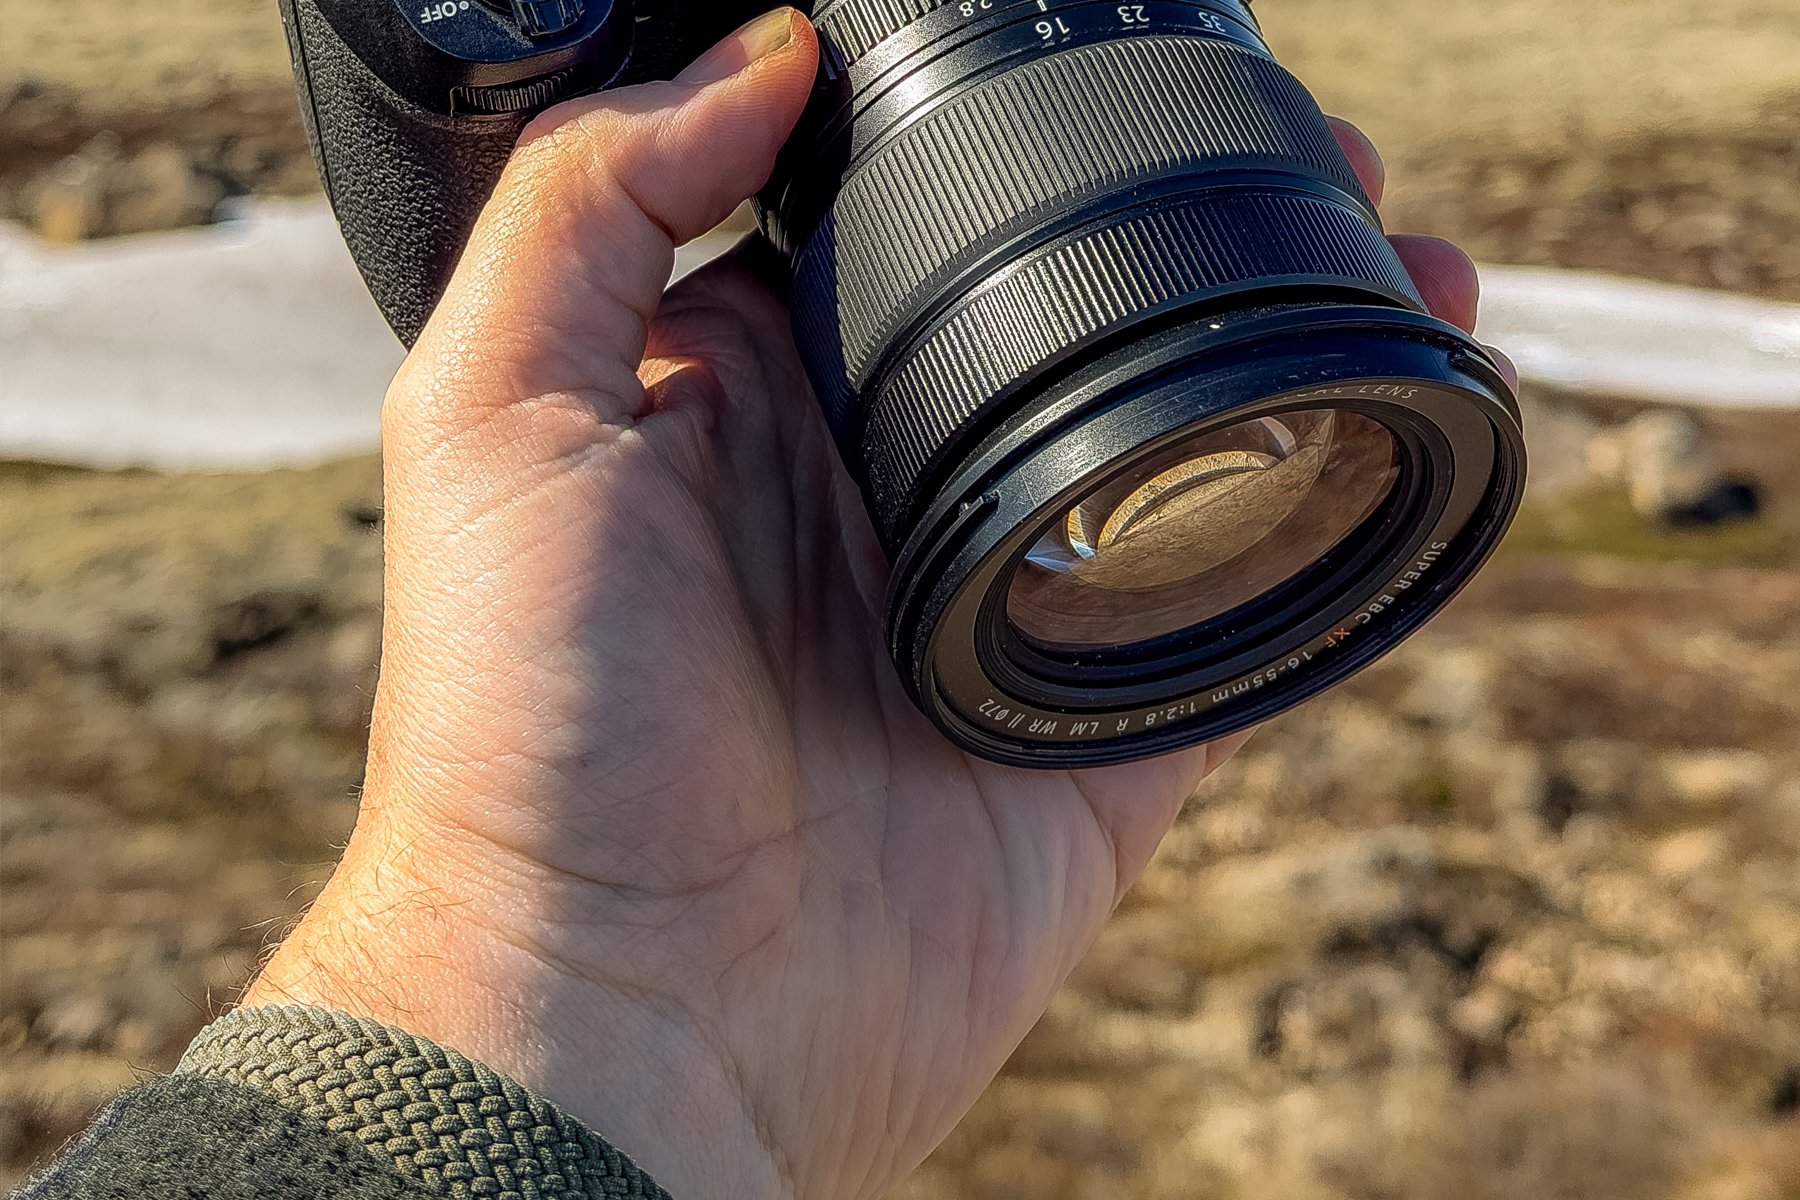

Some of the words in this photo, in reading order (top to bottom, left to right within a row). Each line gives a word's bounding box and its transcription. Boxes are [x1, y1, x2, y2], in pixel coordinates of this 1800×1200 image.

[420, 1, 457, 24] OFF
[1035, 16, 1071, 40] 16
[1117, 5, 1150, 23] 23
[1198, 11, 1226, 33] 35
[1358, 384, 1419, 399] LENS
[1393, 541, 1448, 590] SUPER
[1354, 594, 1395, 624] EBC
[1325, 627, 1350, 648] XF
[1212, 650, 1313, 703] 16-55mm
[1116, 717, 1129, 731] R
[1145, 702, 1197, 726] 1:2.8
[1028, 718, 1058, 735] WR
[1069, 721, 1100, 736] LM
